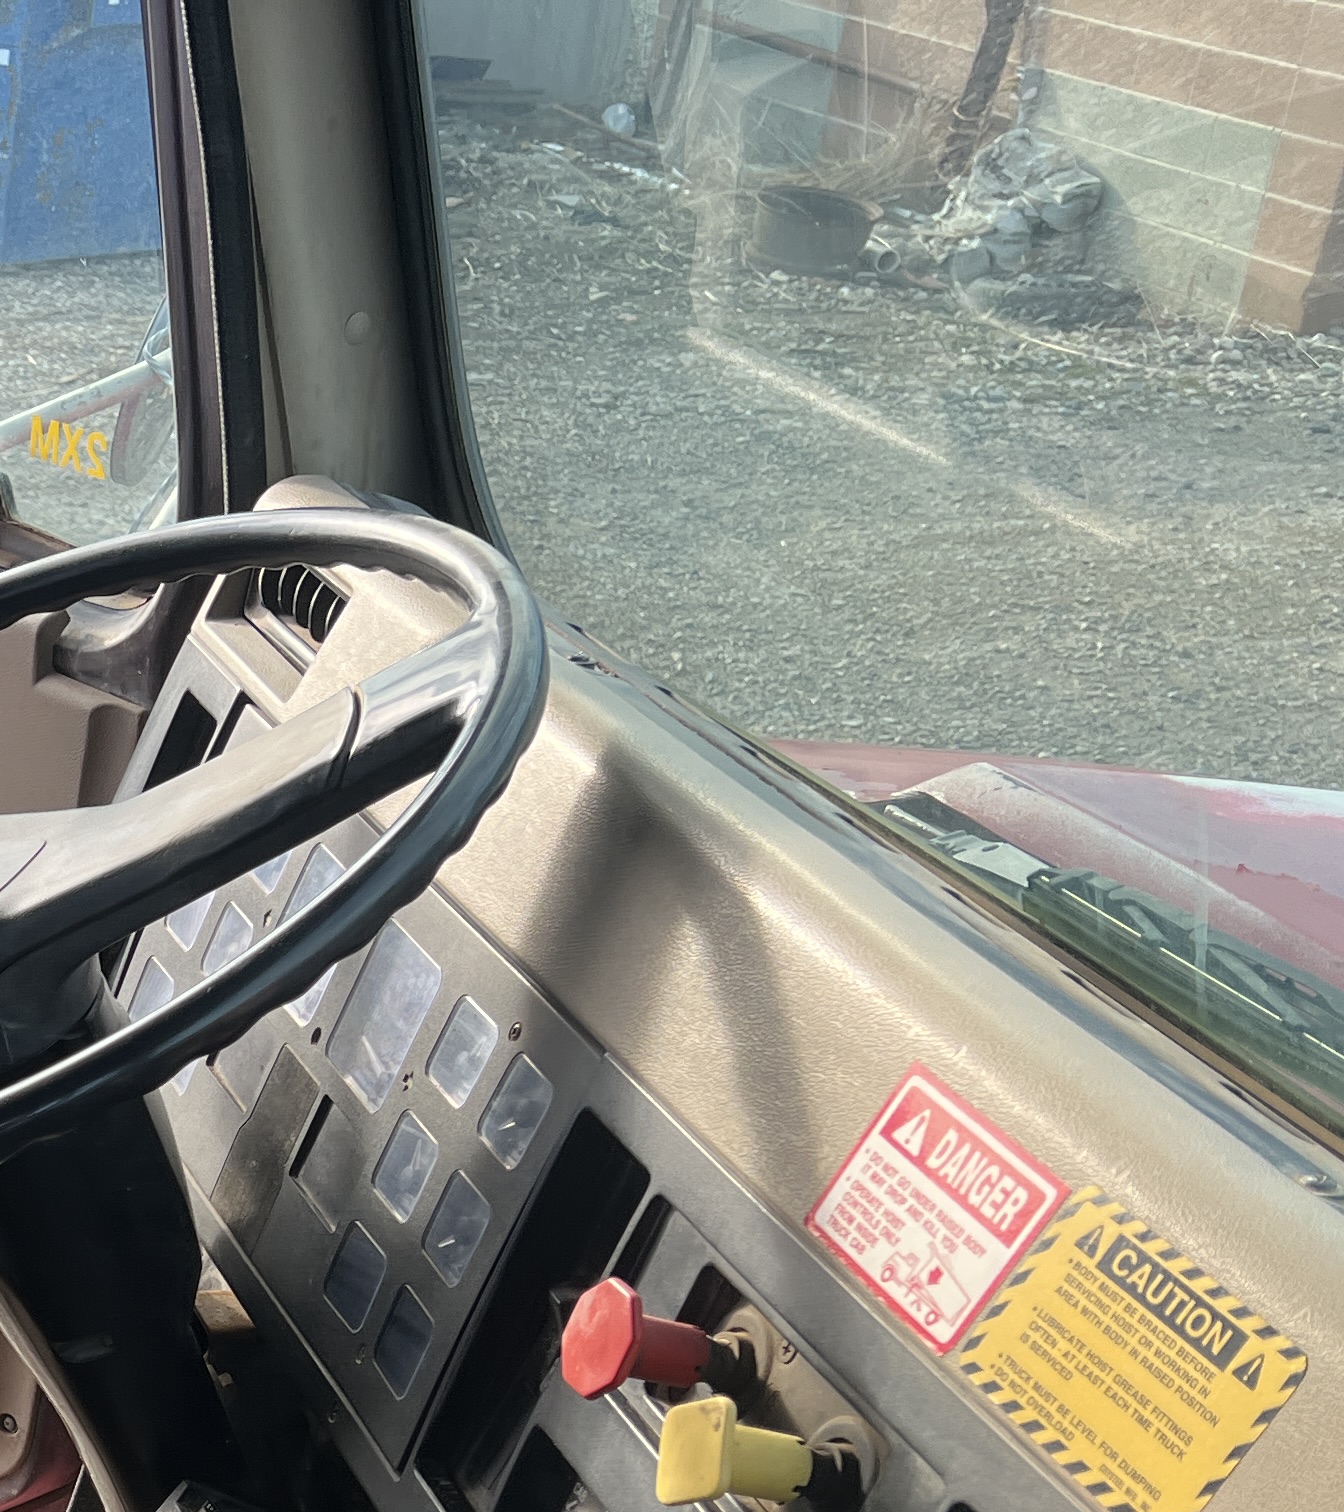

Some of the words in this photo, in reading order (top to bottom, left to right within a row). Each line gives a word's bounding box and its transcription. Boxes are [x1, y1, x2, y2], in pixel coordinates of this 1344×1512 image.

[825, 1213, 851, 1241] TRUCK
[841, 1189, 881, 1230] CONTROLS
[878, 1224, 900, 1248] ONLY
[849, 1178, 883, 1212] OPERATE
[908, 1185, 937, 1215] UNDER
[961, 1234, 986, 1259] BODY
[925, 1126, 1030, 1232] DANGER
[921, 1217, 941, 1239] KILL
[938, 1234, 958, 1255] YOU
[1062, 1273, 1111, 1316] SERVICING
[1109, 1311, 1139, 1339] HOIST
[1137, 1334, 1154, 1352] OR
[1152, 1347, 1200, 1390] WORKING
[1197, 1384, 1211, 1399] IN
[1071, 1261, 1098, 1285] BODY
[1097, 1281, 1124, 1307] MUST
[1122, 1302, 1138, 1318] BE
[1136, 1313, 1177, 1350] BRACED
[1175, 1345, 1217, 1382] BEFORE
[1111, 1247, 1234, 1356] CAUTION
[994, 1365, 1009, 1382] DO
[1007, 1377, 1028, 1400] NOT
[1026, 1395, 1075, 1443] OVERLOAD
[1028, 1339, 1074, 1382] SERVICED
[1028, 1319, 1058, 1349] OFTEN
[1061, 1348, 1076, 1364] AT
[1074, 1360, 1105, 1390] LEAST
[1103, 1385, 1131, 1413] EACH
[1129, 1408, 1154, 1433] TIME
[1152, 1428, 1187, 1462] TRUCK
[1036, 1308, 1087, 1354] LUBRICATE
[1084, 1349, 1114, 1377] HOIST
[1111, 1373, 1152, 1411] GREASE
[1149, 1406, 1194, 1447] FITTINGS
[1054, 1284, 1080, 1309] AREA
[1079, 1305, 1104, 1329] WITH
[1101, 1324, 1130, 1351] BODY
[1127, 1346, 1141, 1360] IN
[1138, 1355, 1176, 1390] RAISED
[1173, 1385, 1220, 1428] POSITION
[1002, 1353, 1033, 1385] TRUCK
[1031, 1380, 1057, 1407] MUST
[1055, 1402, 1071, 1419] BE
[1068, 1414, 1100, 1446] LEVEL
[1097, 1440, 1119, 1463] FOR
[1117, 1458, 1162, 1502] DUMPING
